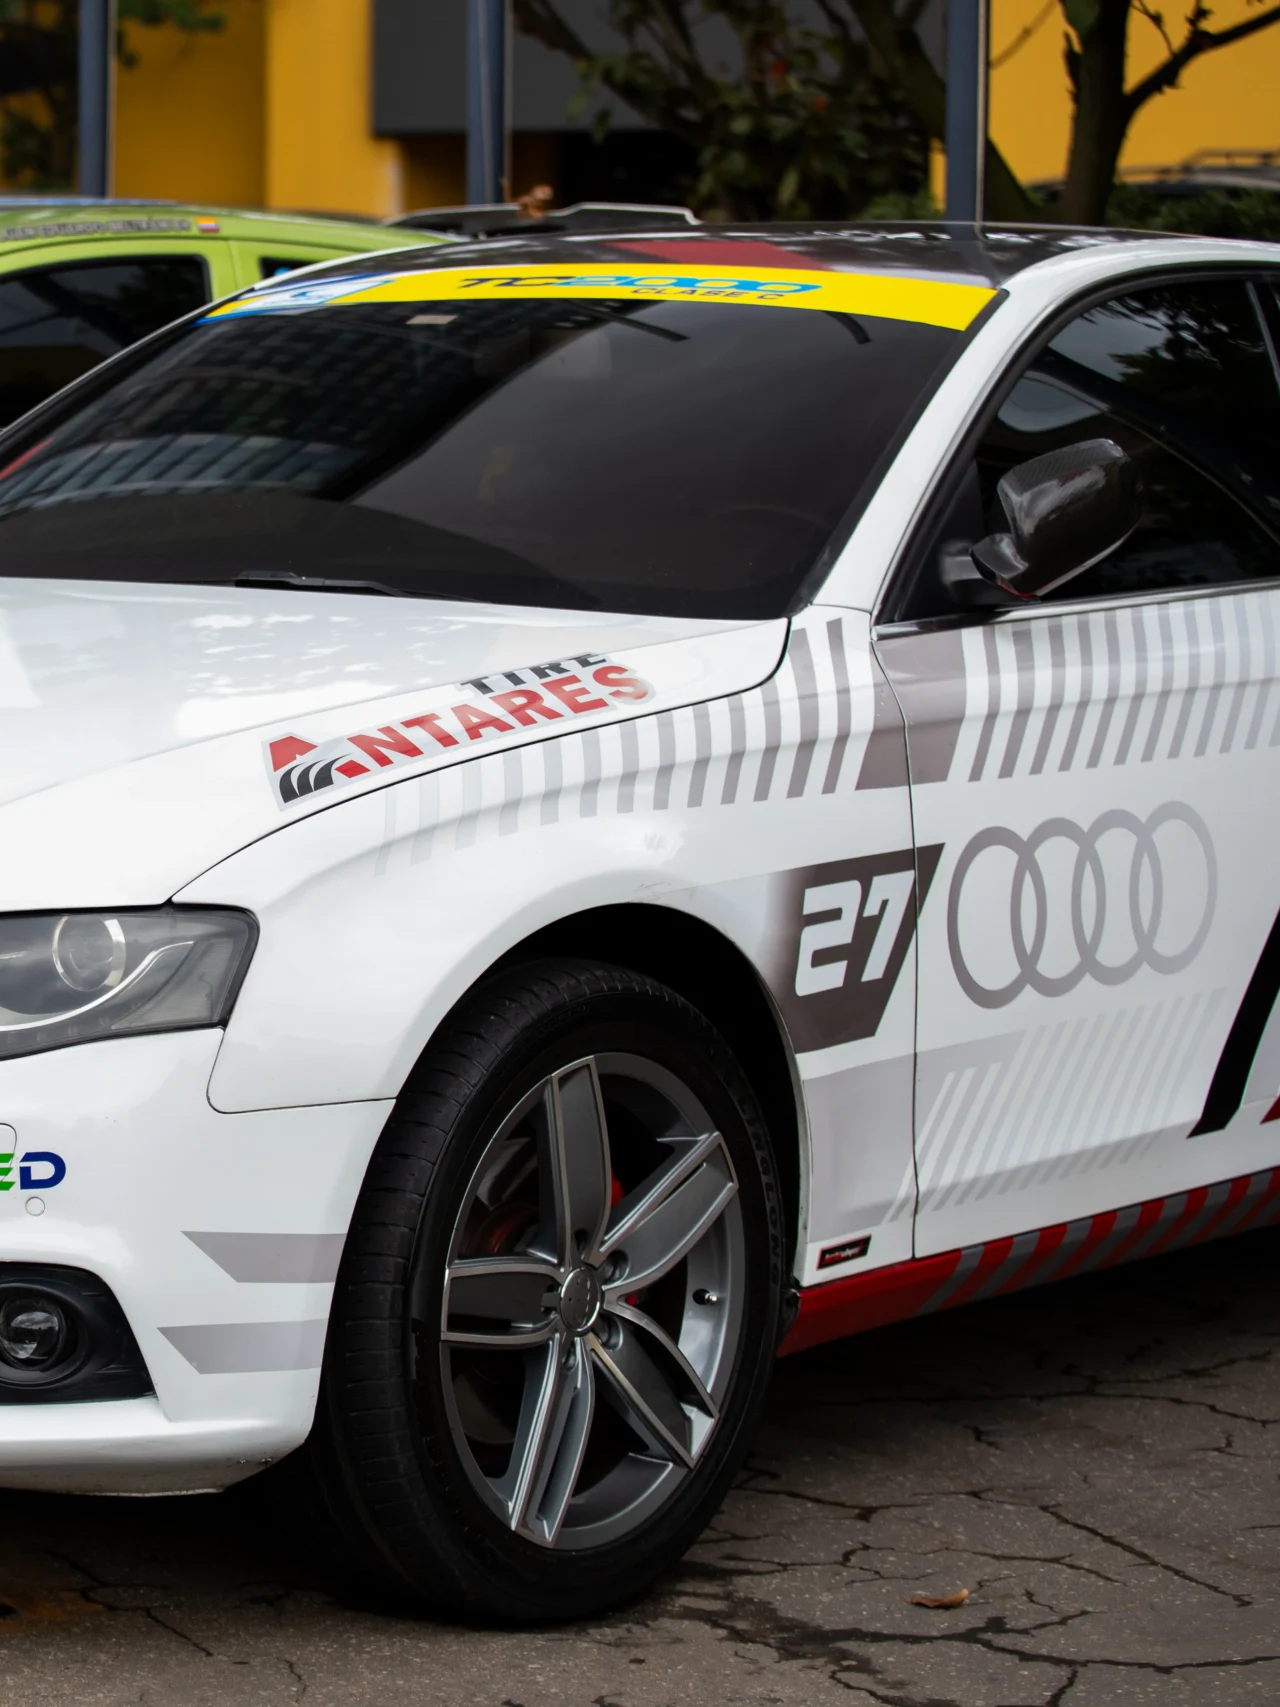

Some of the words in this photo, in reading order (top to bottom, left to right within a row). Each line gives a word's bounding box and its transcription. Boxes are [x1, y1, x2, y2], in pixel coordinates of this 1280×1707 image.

[458, 274, 823, 294] TC2000
[630, 287, 742, 299] CLASE
[755, 293, 786, 301] C
[460, 653, 607, 695] TIRE
[269, 665, 650, 804] ANTARES
[795, 869, 915, 996] 27
